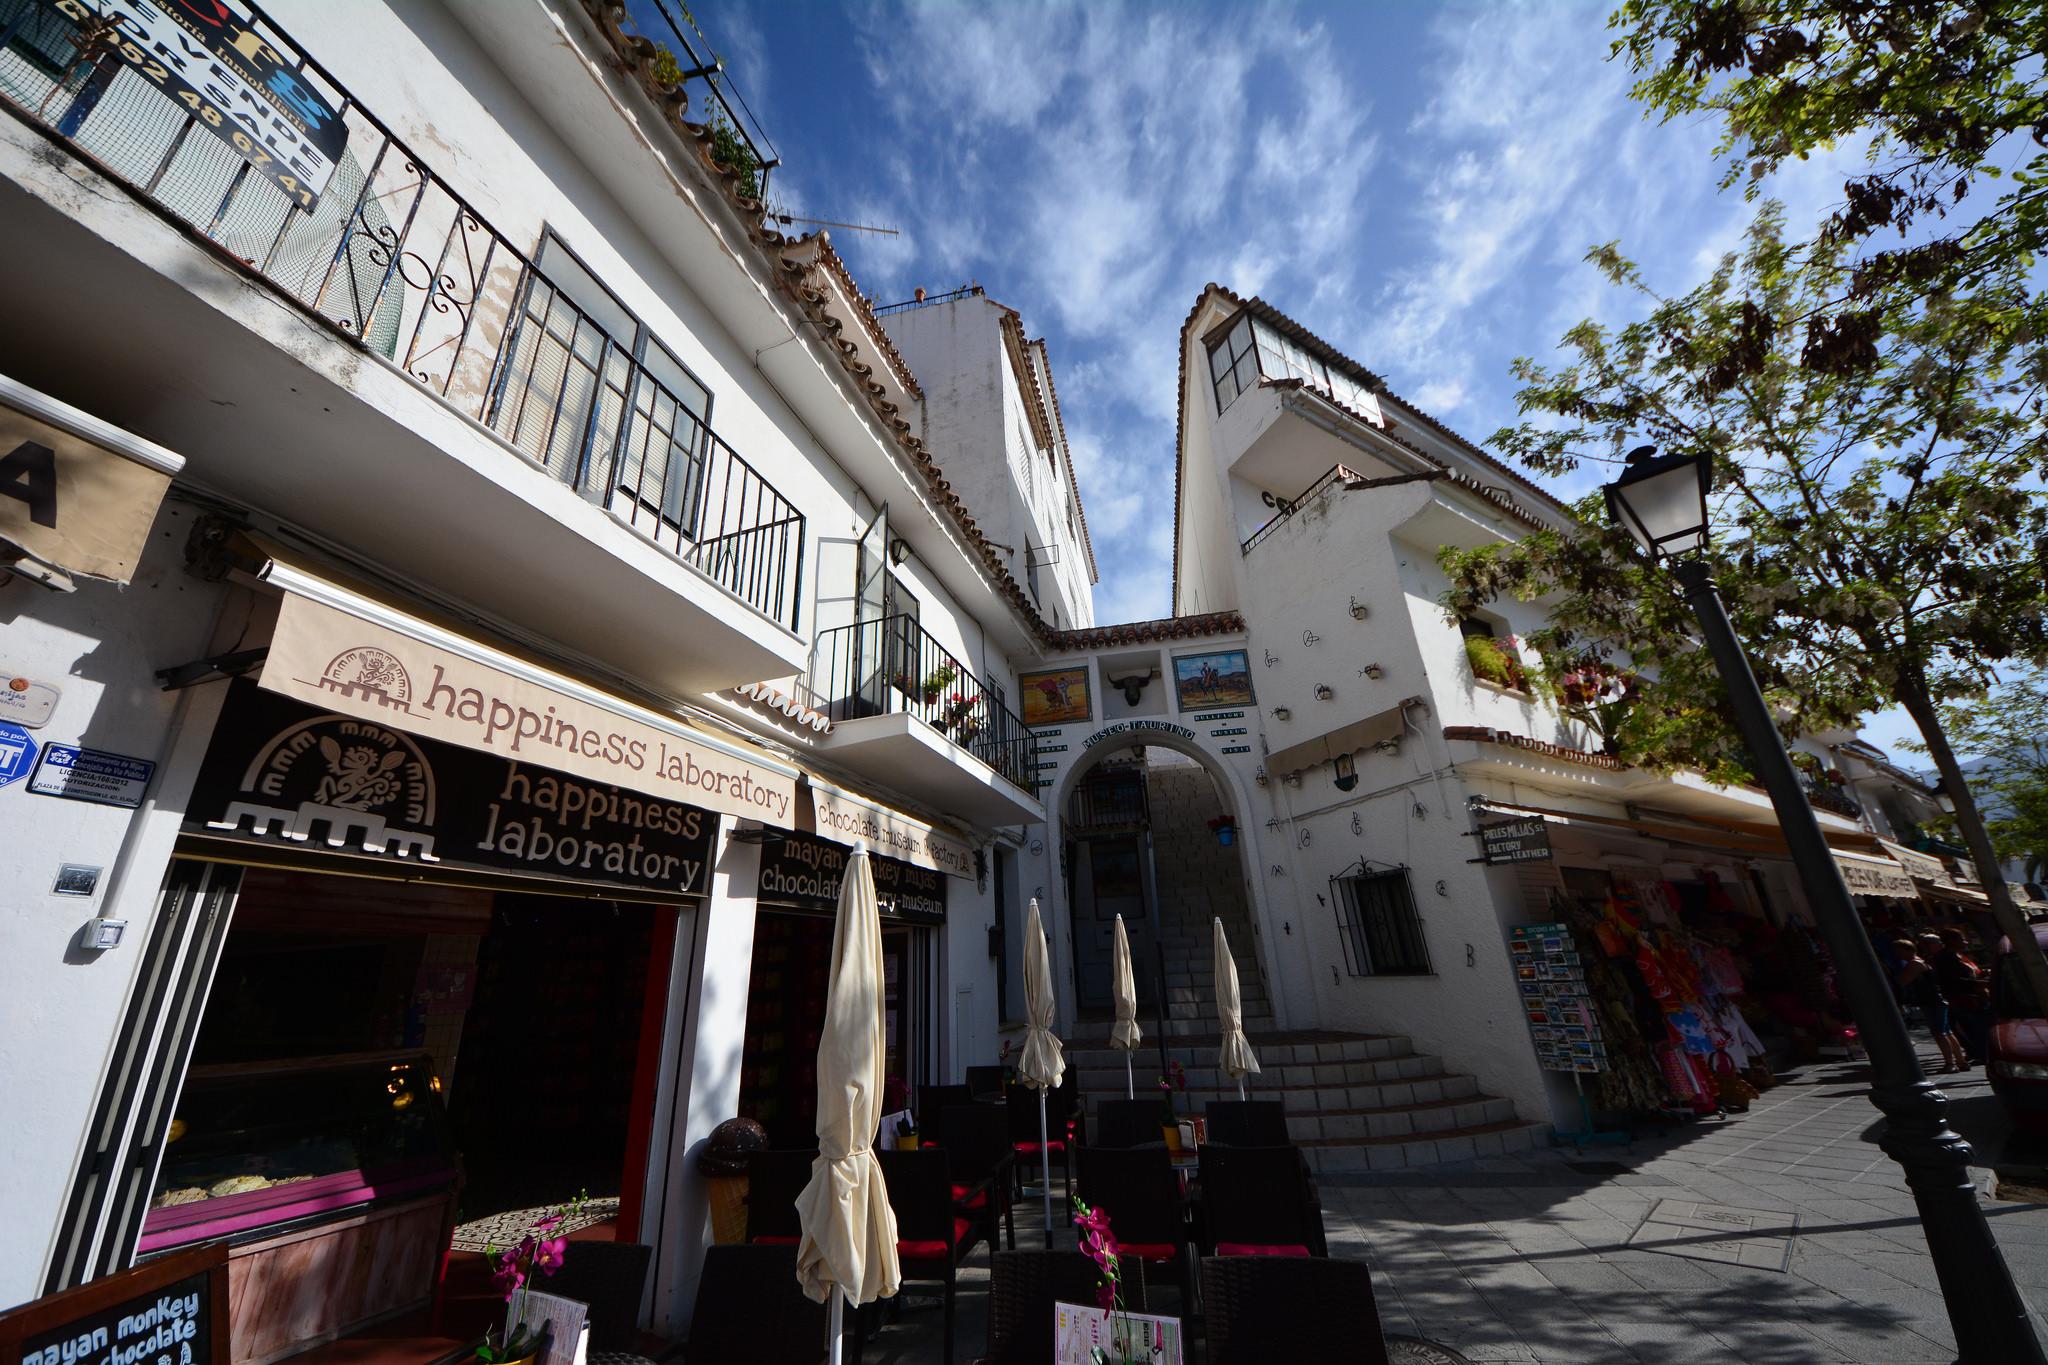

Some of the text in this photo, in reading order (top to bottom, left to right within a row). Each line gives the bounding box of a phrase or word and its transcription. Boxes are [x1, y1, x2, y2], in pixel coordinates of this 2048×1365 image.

[176, 31, 323, 168] VENDE
[216, 46, 306, 134] Inmobiliaria
[177, 88, 223, 128] 48
[232, 131, 273, 175] 67
[278, 175, 312, 205] 41
[204, 82, 313, 182] SALE
[10, 733, 27, 741] por
[422, 664, 790, 819] happiness laboratory
[1211, 728, 1247, 737] MUSEUM
[502, 762, 701, 841] happiness
[1483, 827, 1507, 840] PIELES
[1507, 822, 1535, 838] MIJAS
[477, 803, 700, 892] laboratory
[783, 838, 843, 871] mayan
[905, 866, 936, 890] mijas
[1488, 840, 1521, 854] FACTORY
[1512, 848, 1549, 859] LEATHER
